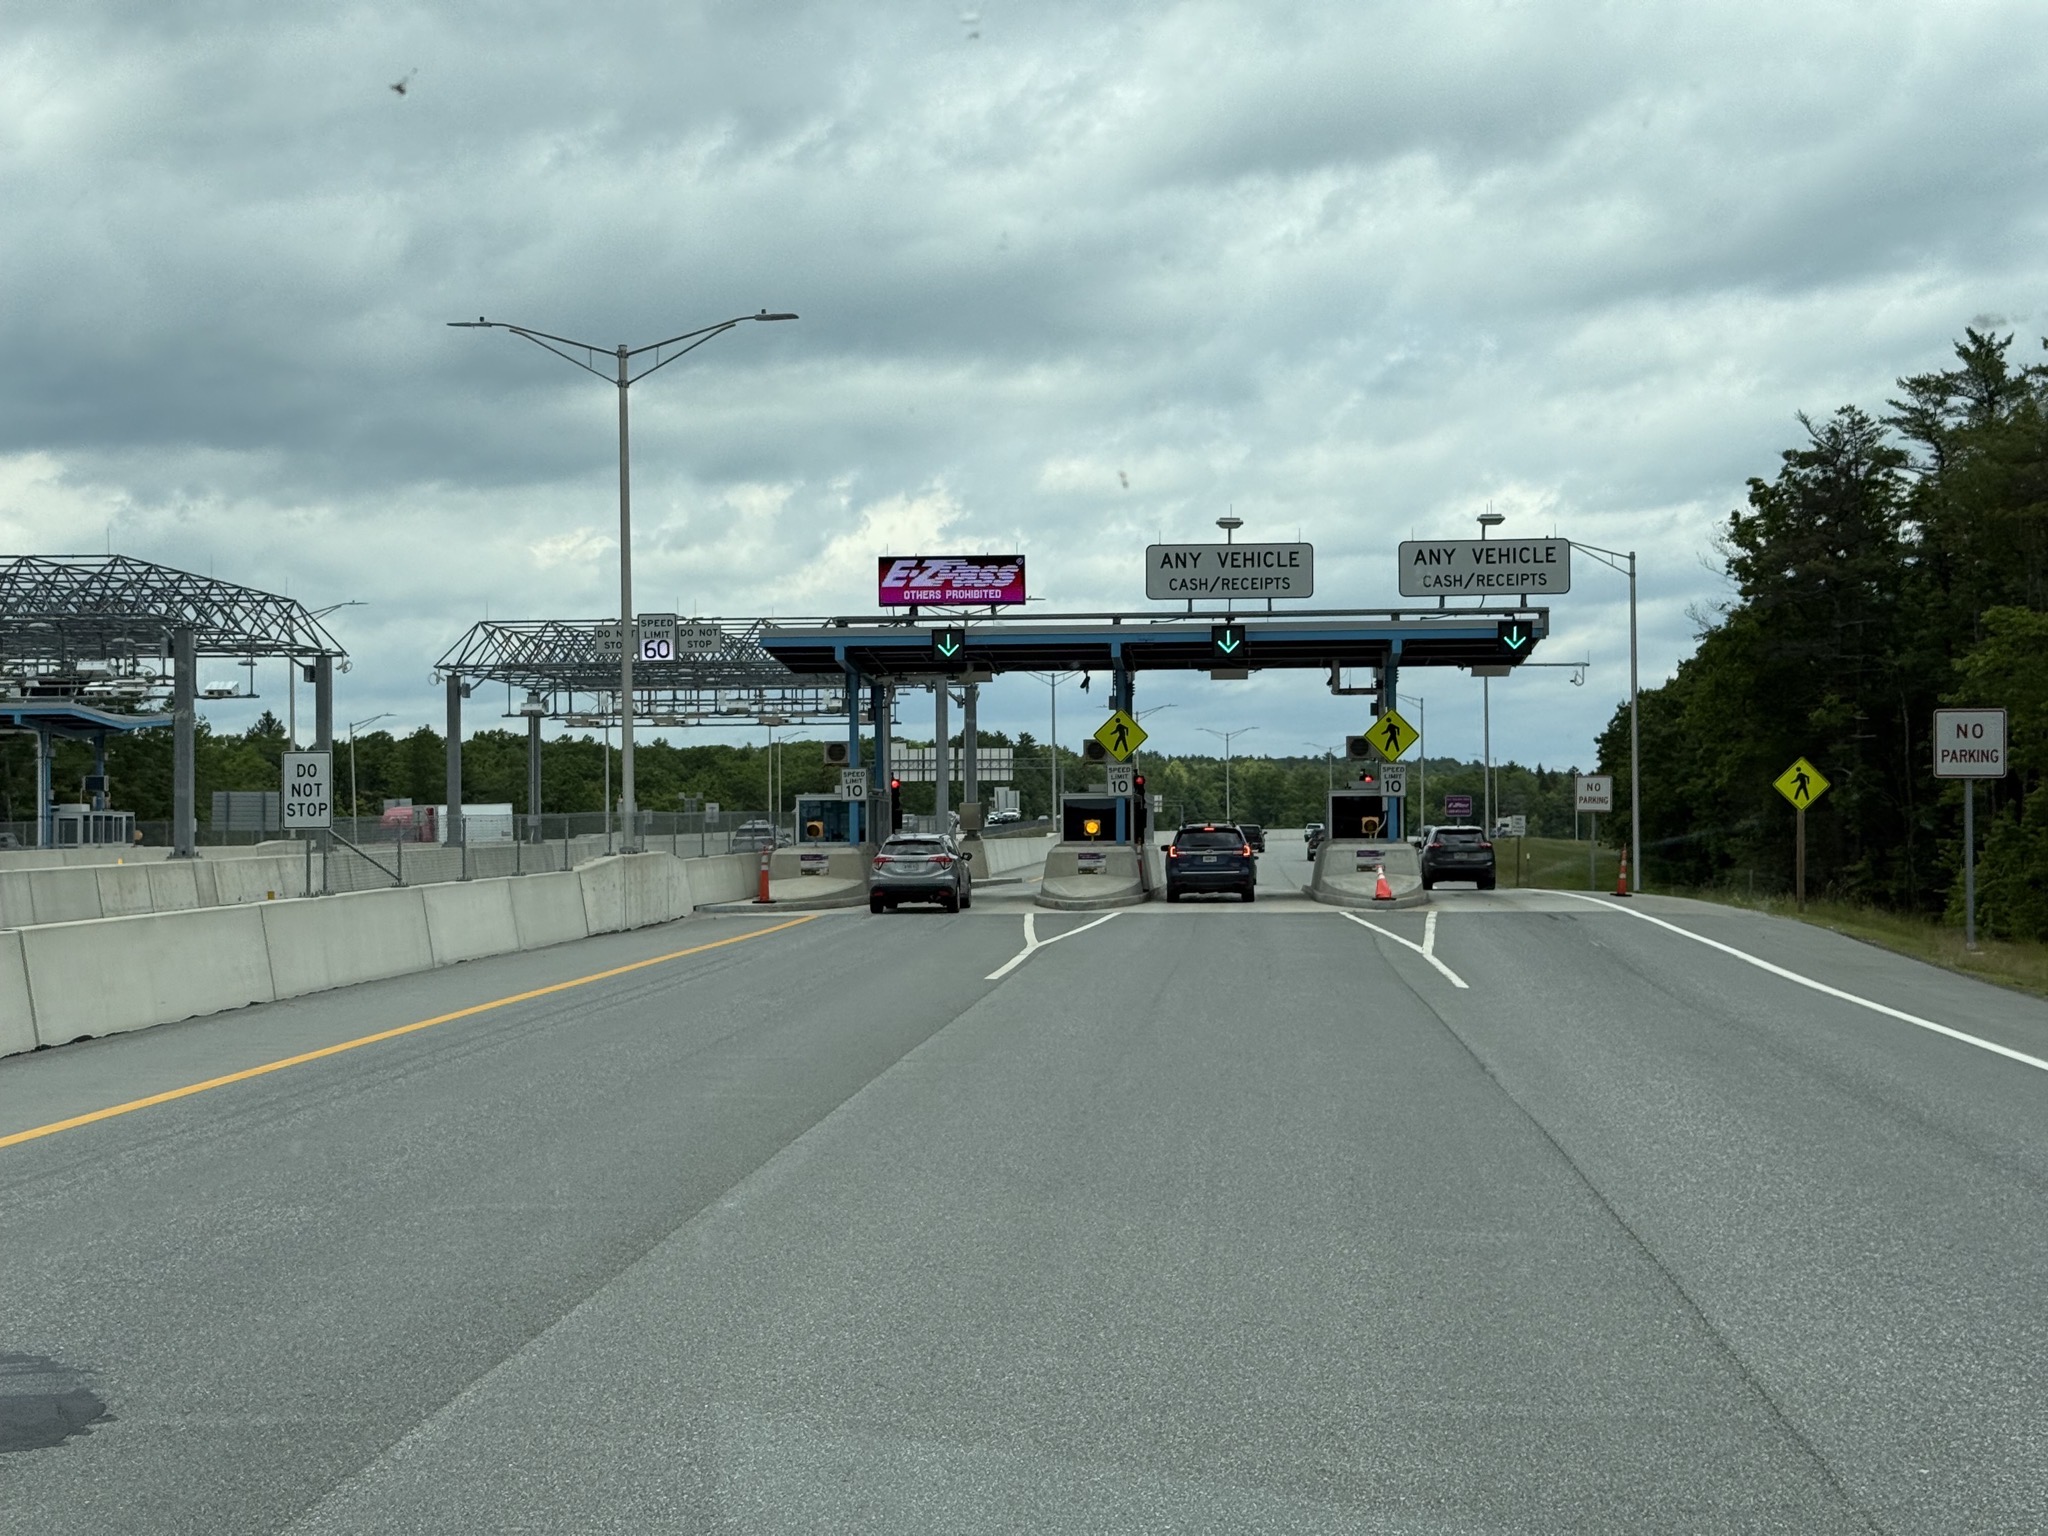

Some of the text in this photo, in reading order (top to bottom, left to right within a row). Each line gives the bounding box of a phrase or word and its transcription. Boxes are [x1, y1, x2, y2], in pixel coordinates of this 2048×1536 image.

[1160, 551, 1300, 569] ANY VEHICLE
[1414, 546, 1556, 566] ANY VEHICLE
[1169, 576, 1290, 592] CASH/RECEIPTS
[1422, 572, 1547, 589] CASH/RECEIPTS
[903, 589, 1002, 600] OTHERS PROHIBITED
[641, 619, 674, 627] SPEED
[597, 629, 611, 638] DO
[644, 630, 670, 639] LIMIT
[680, 628, 719, 637] DO NOT
[604, 641, 622, 650] STO
[644, 639, 670, 659] 60
[687, 640, 713, 649] STOP
[1956, 723, 1983, 739] NO
[1941, 749, 1999, 763] PARKING
[296, 763, 317, 778] DO
[1108, 766, 1131, 774] SPEED
[291, 783, 322, 797] NOT
[846, 785, 863, 797] 10
[1112, 780, 1128, 793] 10
[1385, 780, 1401, 793] 10
[1586, 782, 1601, 791] NO
[1578, 796, 1609, 804] PARKING
[287, 803, 328, 817] STOP
